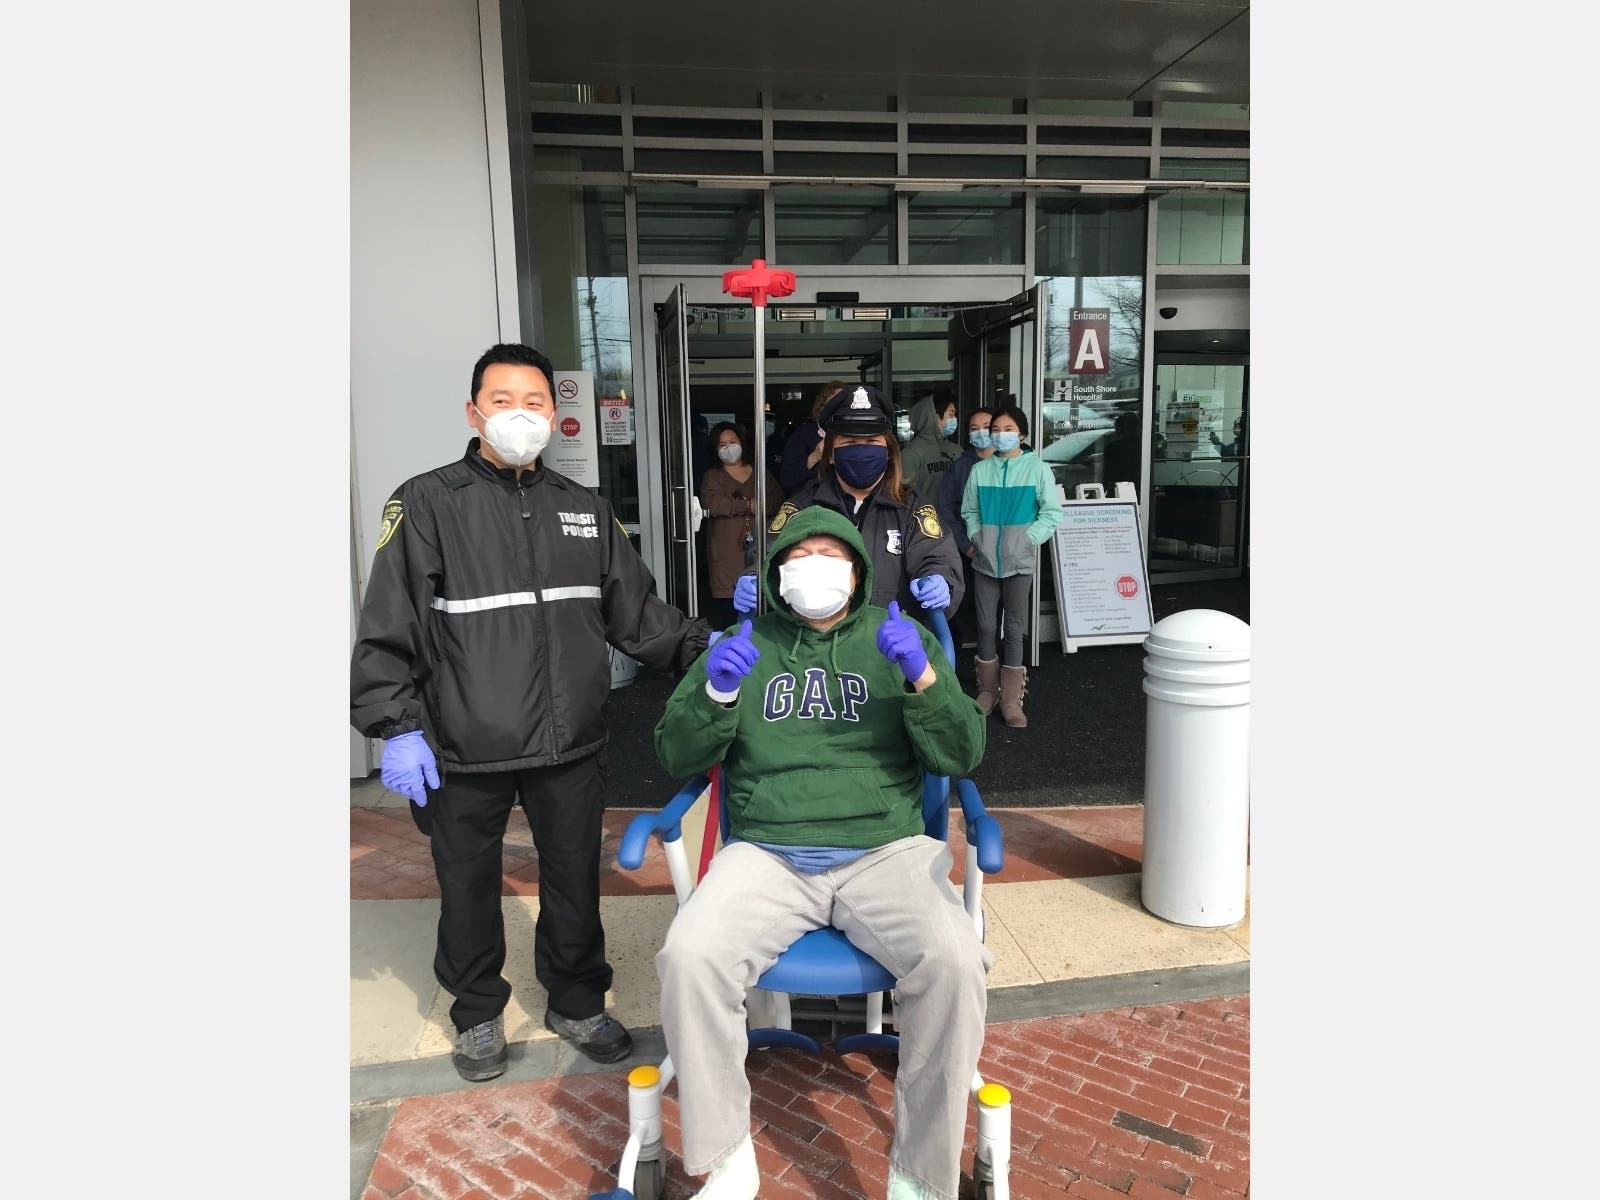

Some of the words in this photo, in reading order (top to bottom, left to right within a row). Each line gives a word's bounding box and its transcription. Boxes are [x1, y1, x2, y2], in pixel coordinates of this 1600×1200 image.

[1073, 310, 1108, 320] Entrance
[1073, 328, 1105, 369] A
[1073, 385, 1095, 393] South
[1096, 385, 1117, 393] Shore
[1073, 393, 1103, 402] Hospital
[562, 424, 579, 432] STOP
[558, 512, 596, 525] TRANSIT
[562, 525, 599, 538] POLICE
[1118, 581, 1137, 593] STOP
[763, 667, 869, 722] GAP
